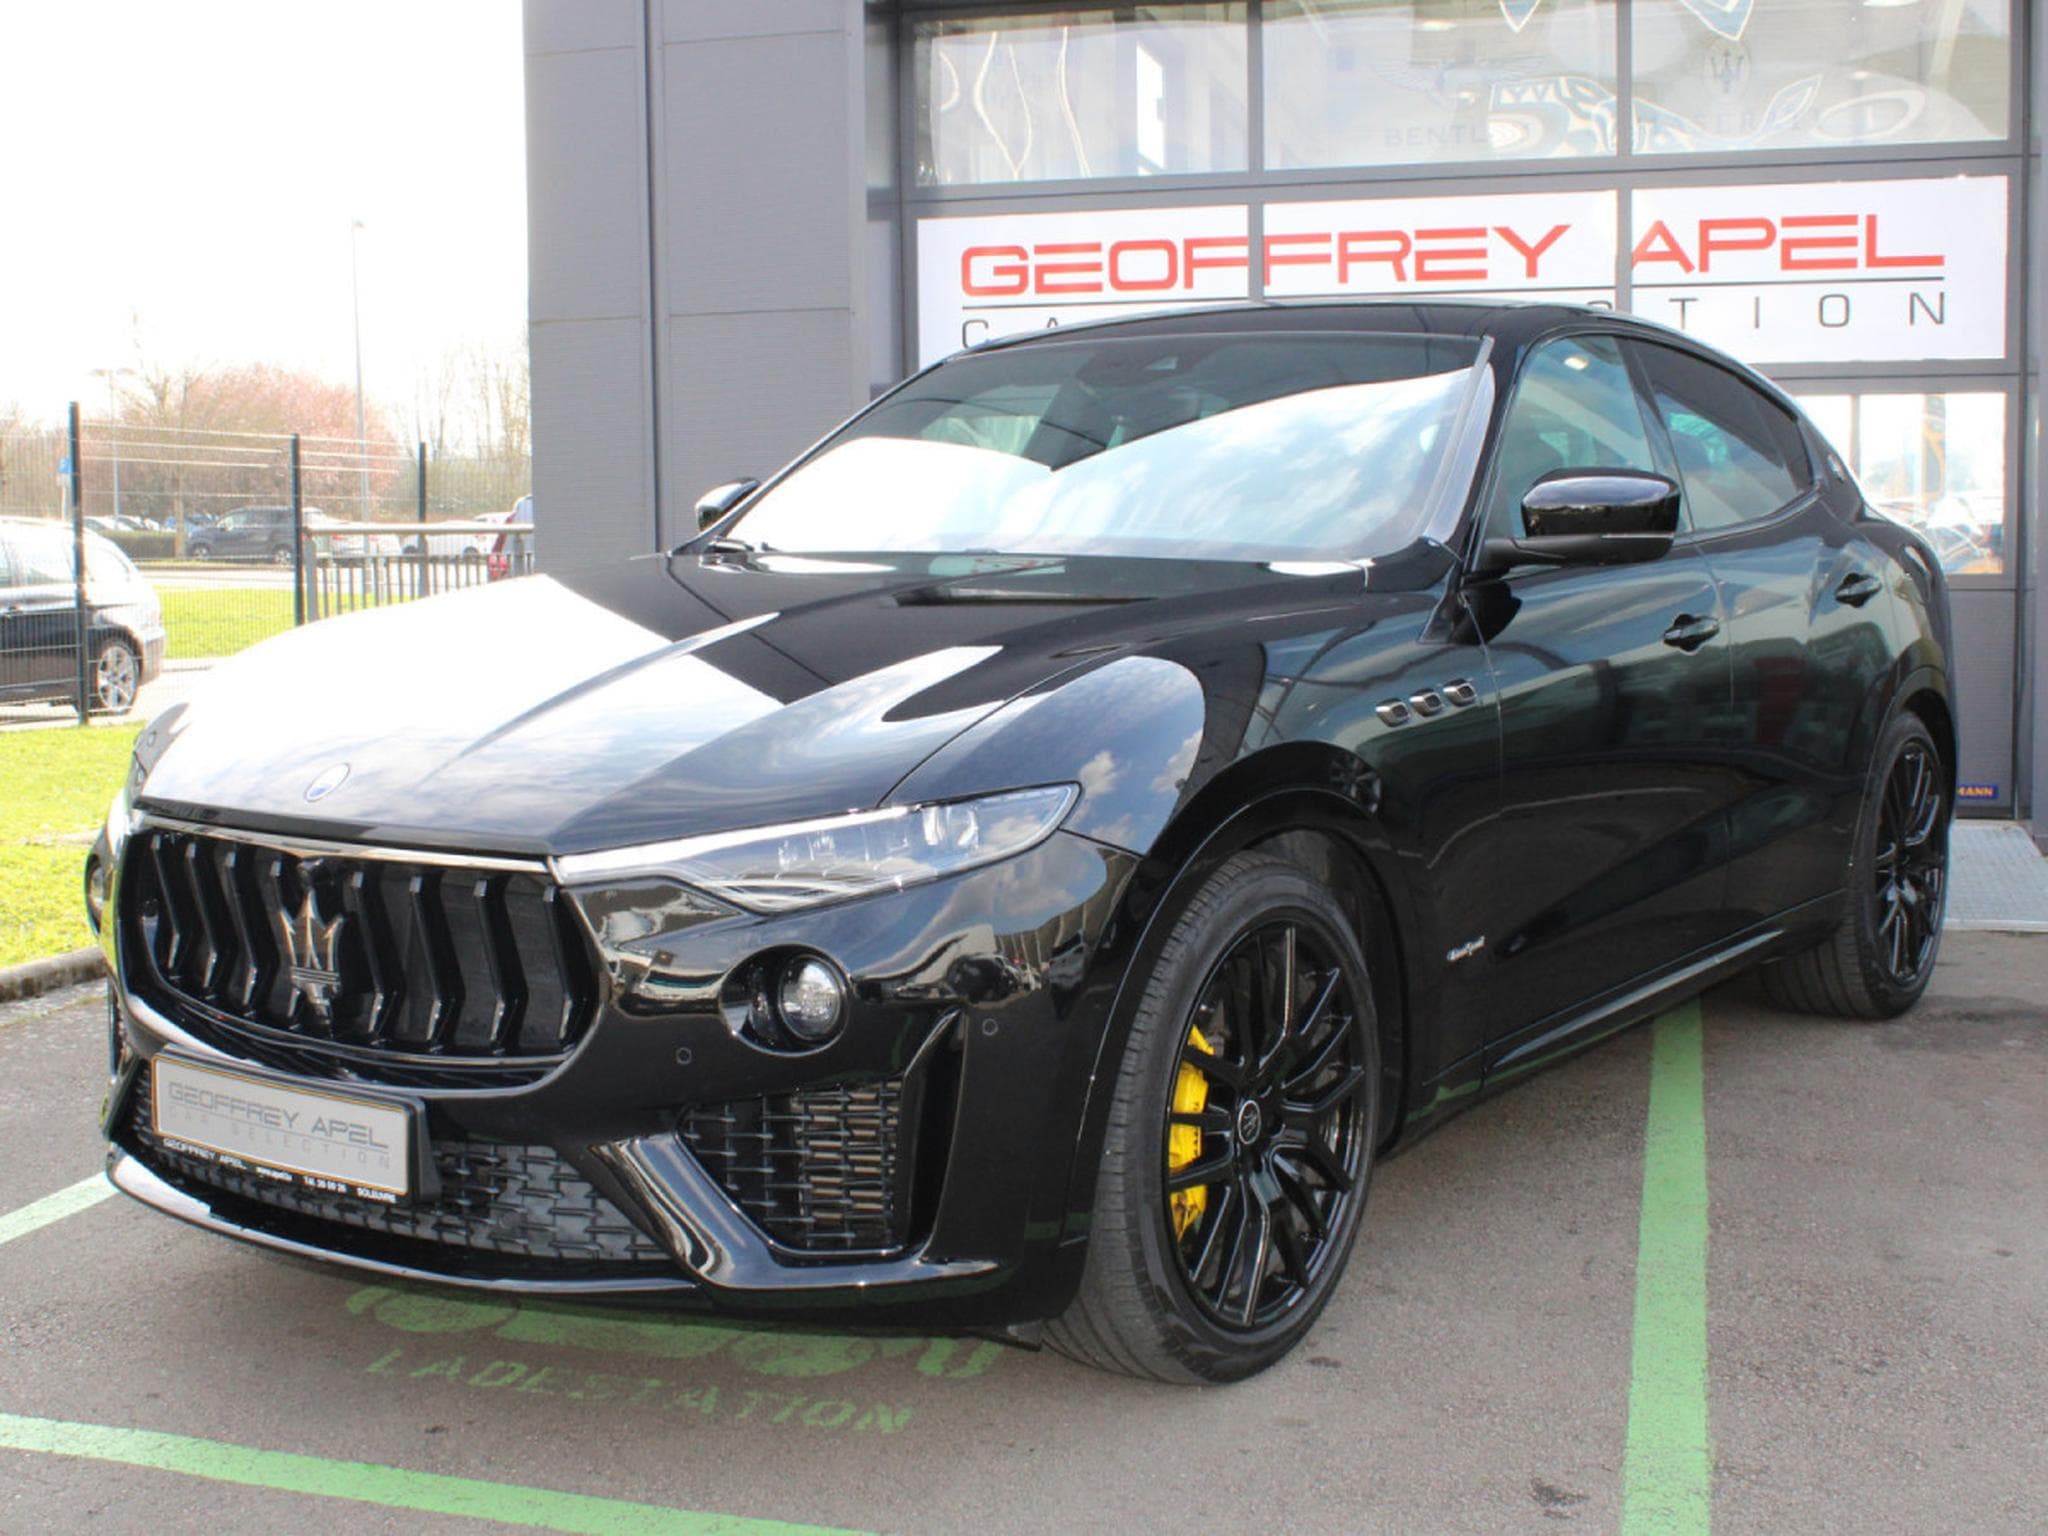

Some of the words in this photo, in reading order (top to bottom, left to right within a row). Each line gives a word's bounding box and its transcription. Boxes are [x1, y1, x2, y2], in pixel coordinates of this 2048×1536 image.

[961, 223, 1571, 297] GEOFFREY
[1632, 214, 1945, 273] APEL
[168, 1082, 299, 1128] GEOFFREY
[311, 1115, 390, 1150] APEL
